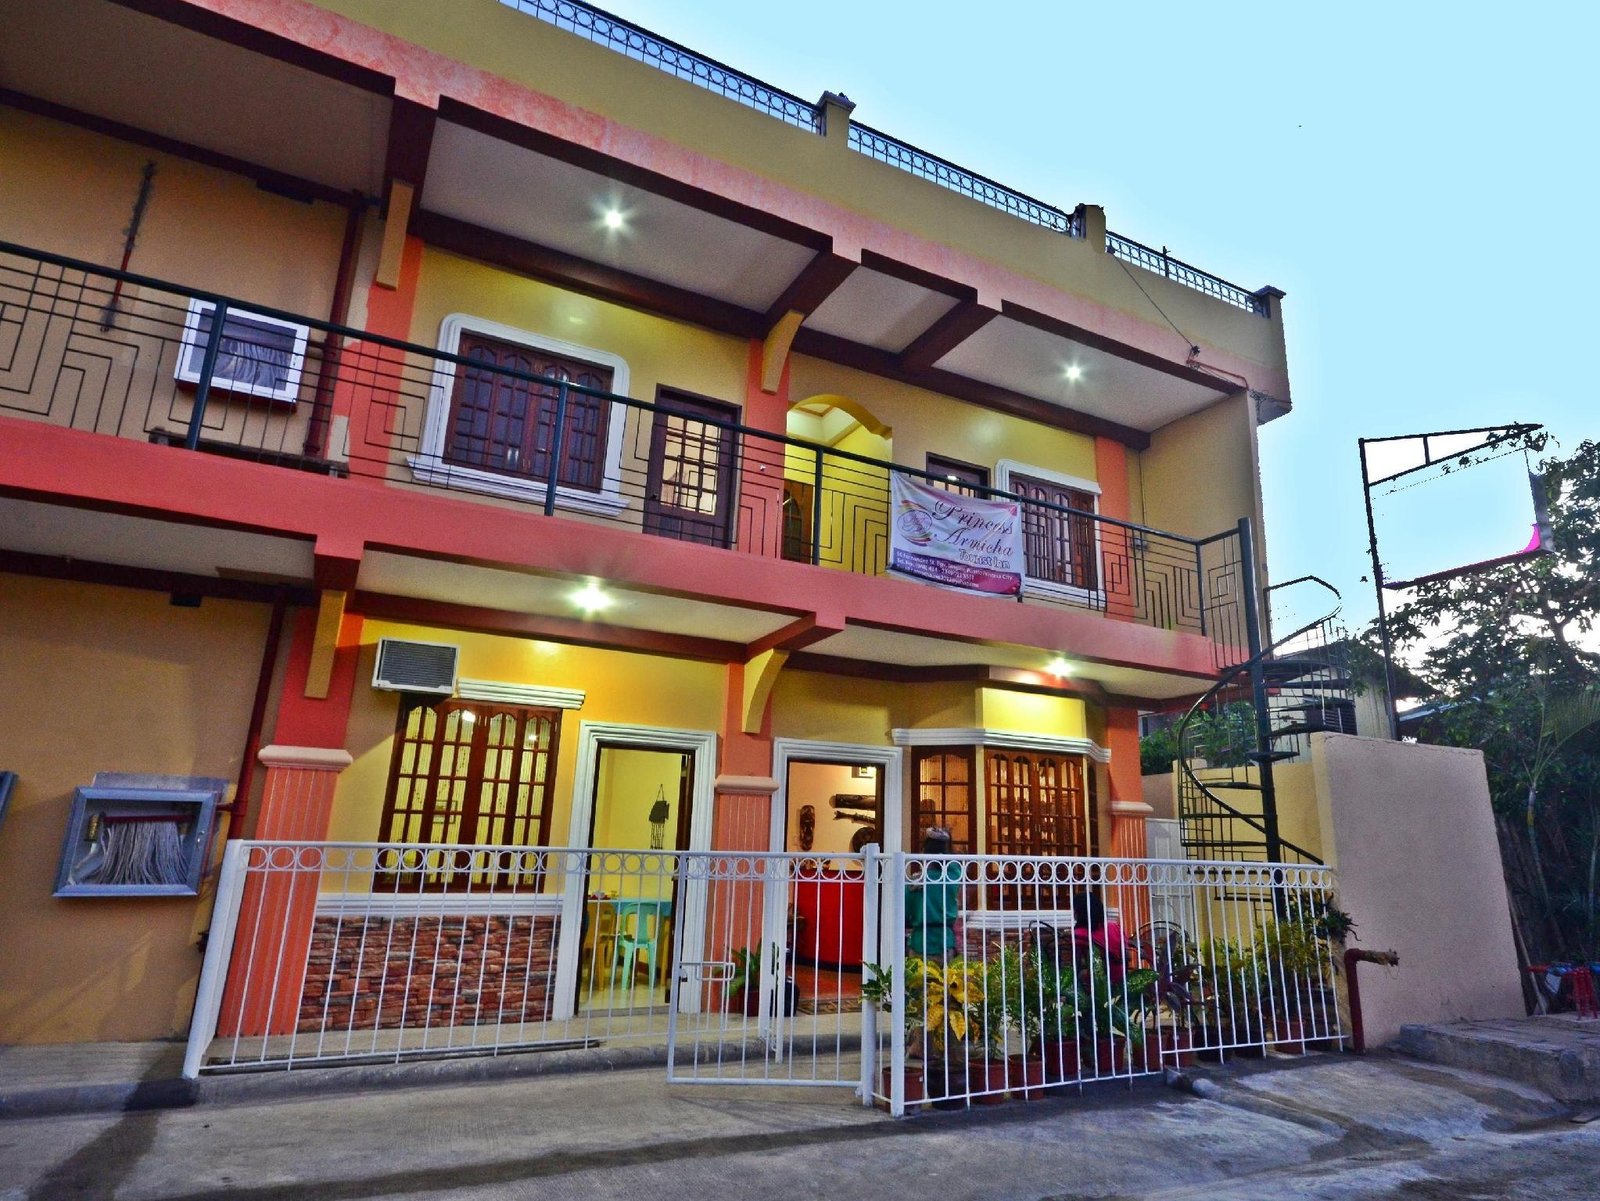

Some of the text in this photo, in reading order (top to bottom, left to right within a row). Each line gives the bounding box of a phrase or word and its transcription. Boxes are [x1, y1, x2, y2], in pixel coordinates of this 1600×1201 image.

[932, 500, 1013, 535] Princess
[935, 527, 1013, 556] Armicha
[959, 548, 1010, 569] Tourist Inn
[1002, 573, 1012, 581] City
